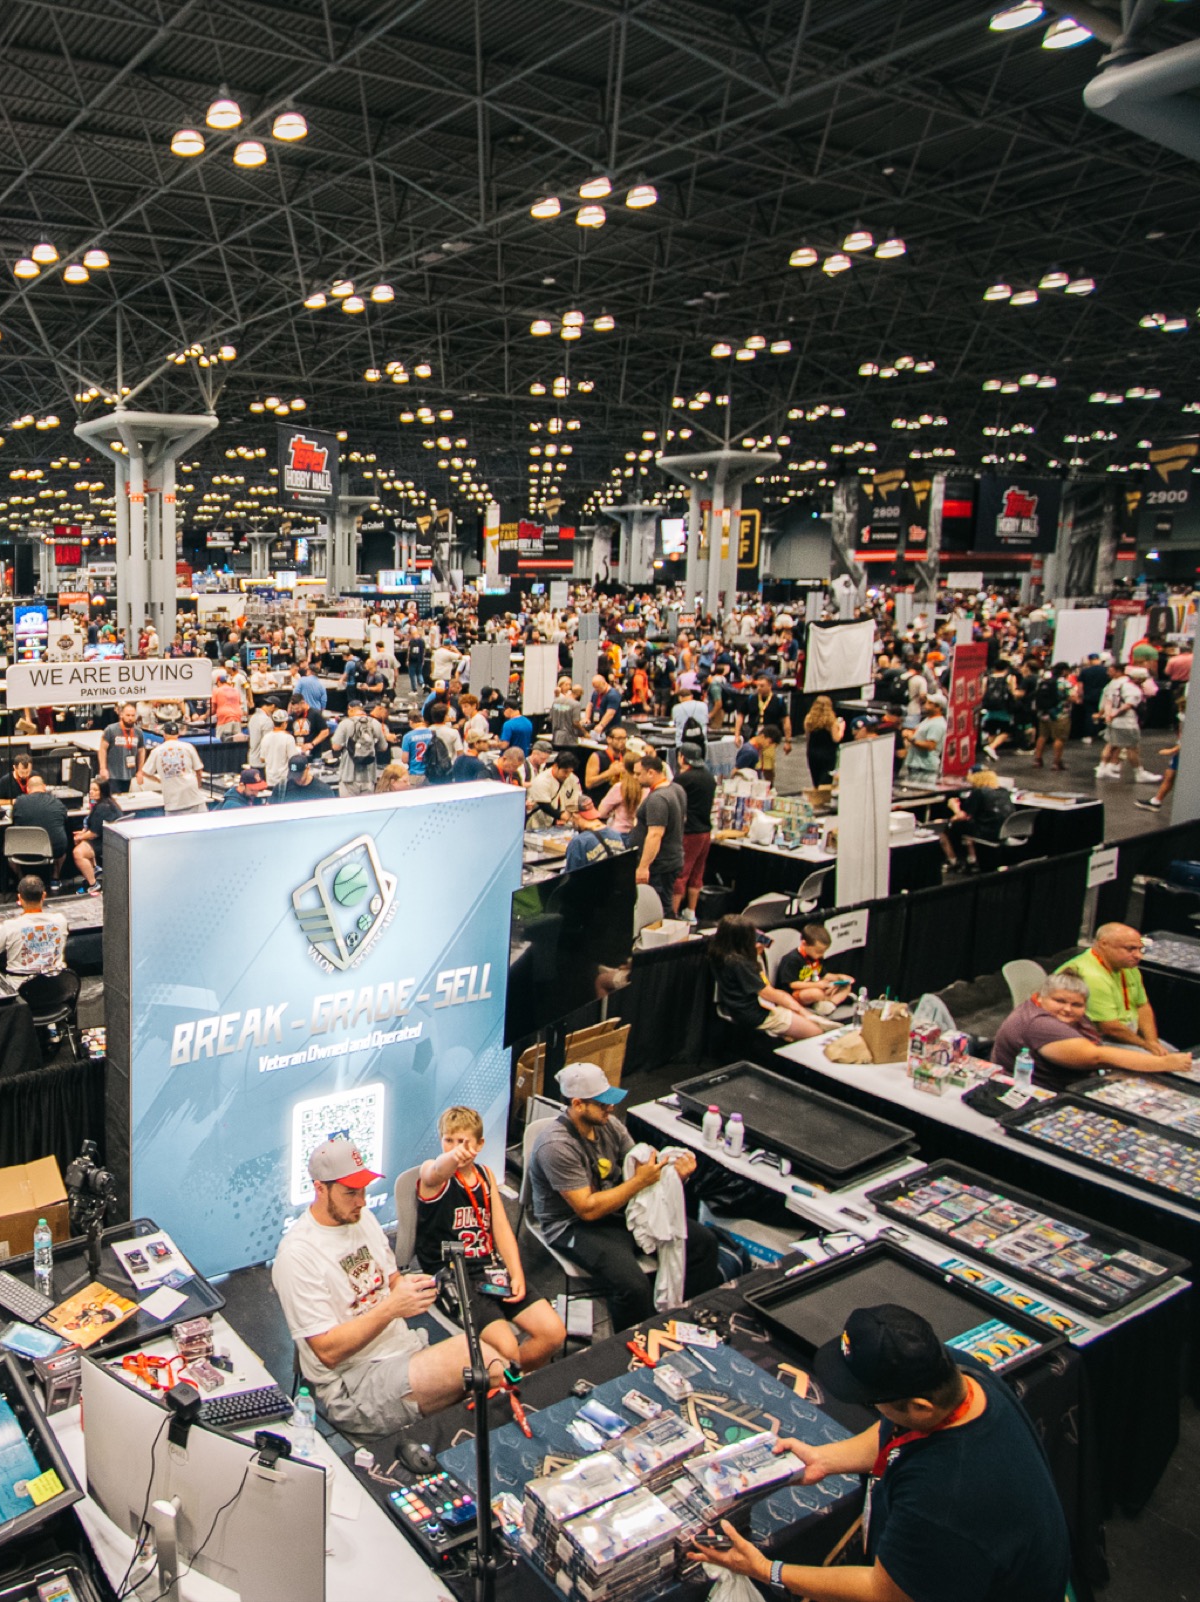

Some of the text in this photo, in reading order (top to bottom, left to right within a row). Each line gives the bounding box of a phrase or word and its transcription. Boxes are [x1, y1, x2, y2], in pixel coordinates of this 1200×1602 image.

[1147, 490, 1188, 504] 2900
[29, 663, 193, 687] WE ARE BUYING
[80, 685, 146, 697] PAYING CASH
[416, 742, 427, 762] 2
[308, 945, 335, 975] VALOR
[170, 1002, 289, 1068] BREAK
[310, 977, 416, 1036] GRADE
[433, 963, 492, 1010] SELL
[259, 1021, 422, 1073] Veteran Owned and Operated
[458, 1230, 492, 1258] 23
